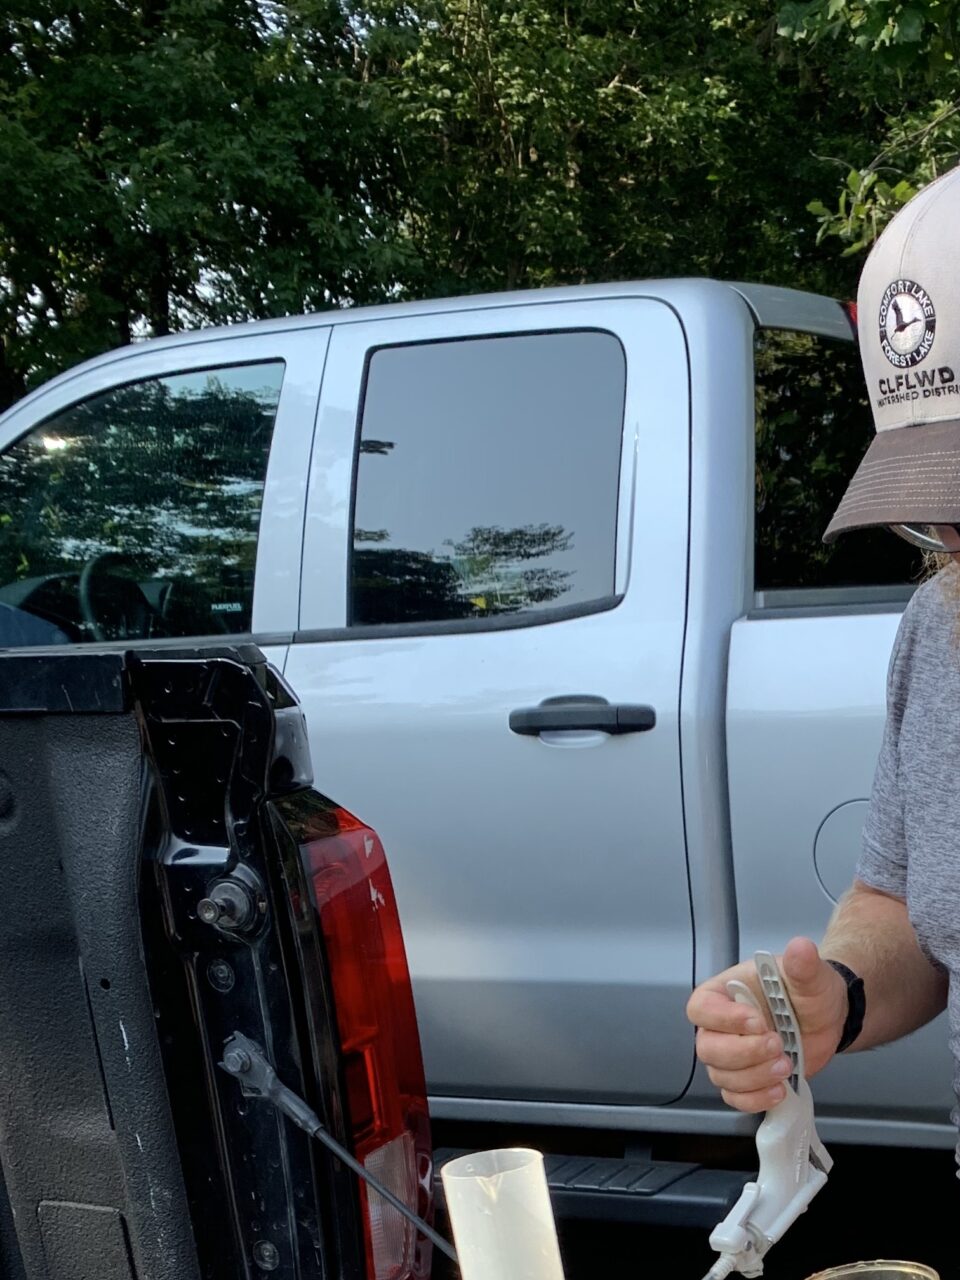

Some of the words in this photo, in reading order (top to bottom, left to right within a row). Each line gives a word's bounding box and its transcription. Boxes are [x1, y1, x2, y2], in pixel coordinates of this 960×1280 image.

[879, 281, 911, 326] COMFORT
[911, 283, 934, 317] LAKE
[881, 340, 912, 366] FOREST
[914, 330, 934, 361] LAKE
[878, 366, 955, 395] CLFLWD
